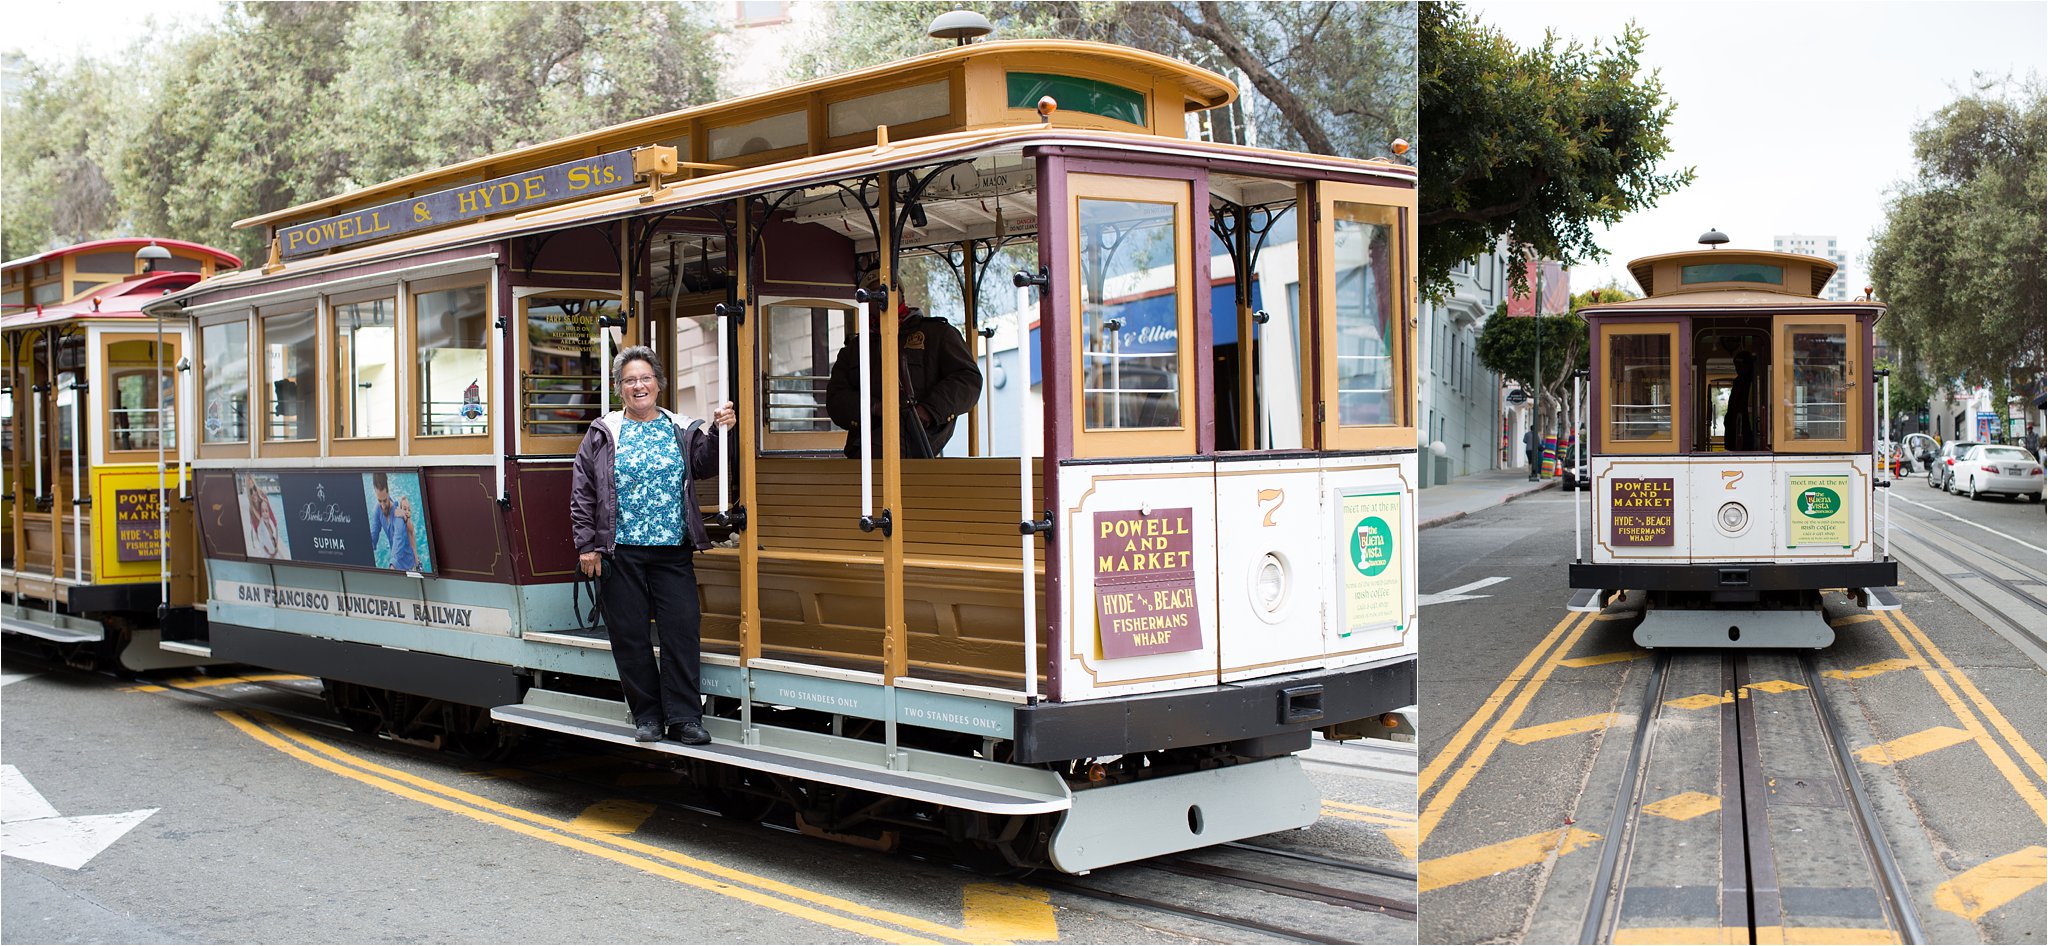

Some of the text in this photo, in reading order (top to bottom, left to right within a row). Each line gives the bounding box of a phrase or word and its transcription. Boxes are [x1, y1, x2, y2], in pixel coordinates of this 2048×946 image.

[983, 175, 1007, 188] MASON
[288, 164, 622, 249] POWELL & HYDE Sts.
[546, 315, 560, 324] FARE
[1615, 482, 1671, 491] POWELL
[1721, 470, 1744, 490] 7
[1257, 488, 1285, 527] 7
[1613, 498, 1672, 507] MARKET
[212, 504, 223, 526] 7
[1614, 516, 1634, 526] HYDE
[1645, 516, 1671, 526] BEACH
[120, 530, 141, 540] HYDE
[1101, 518, 1188, 538] POWELL
[1618, 527, 1666, 535] FISHERMANS
[314, 537, 345, 550] SUPIMA
[1125, 537, 1168, 552] AND
[1629, 534, 1654, 542] WHARF
[1099, 551, 1190, 573] MARKET
[239, 585, 472, 627] SAN FRANCISCO MUNICIPAL RAILWAY
[1103, 594, 1136, 615] HYDE
[1154, 589, 1194, 610] BEACH
[1113, 614, 1188, 633] FISHERMANS
[1133, 631, 1172, 646] WHARF
[702, 678, 719, 688] ONLY
[779, 688, 858, 708] TWO STANDEES ONLY
[904, 707, 996, 729] TWO STANDEES ONLY
